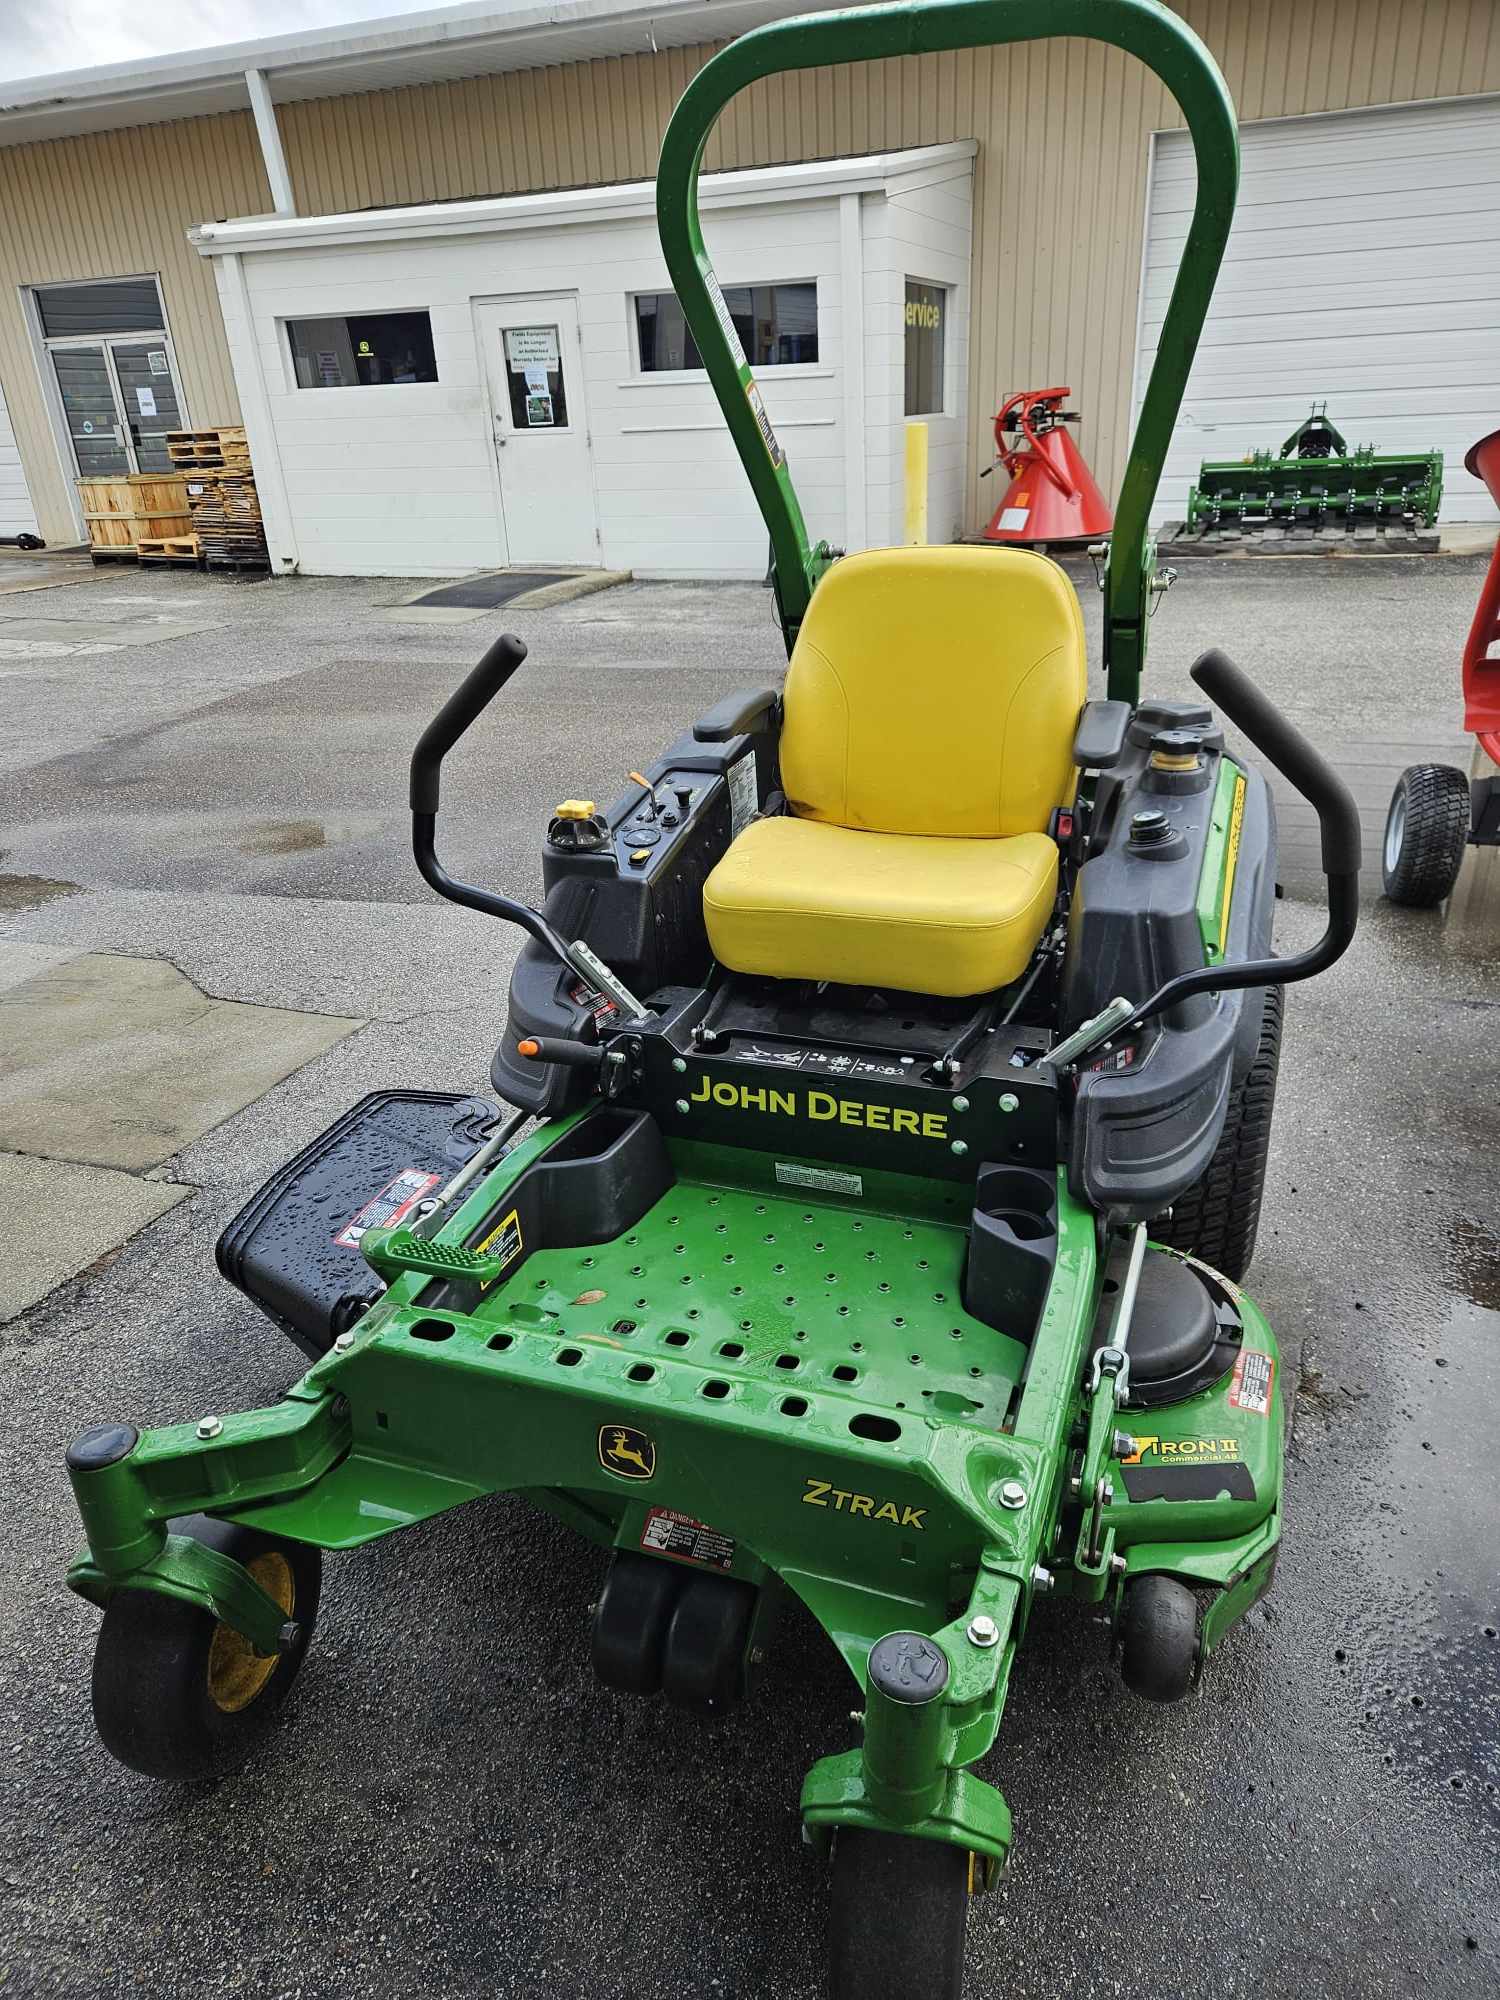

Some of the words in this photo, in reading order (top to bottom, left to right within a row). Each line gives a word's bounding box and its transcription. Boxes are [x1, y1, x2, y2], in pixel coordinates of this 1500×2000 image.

[905, 297, 940, 329] ervice
[691, 1075, 796, 1116] JOHN
[808, 1090, 948, 1139] DEERE
[1152, 1440, 1217, 1455] IRON
[1160, 1454, 1222, 1463] Commercial
[802, 1479, 928, 1529] ZTRAK
